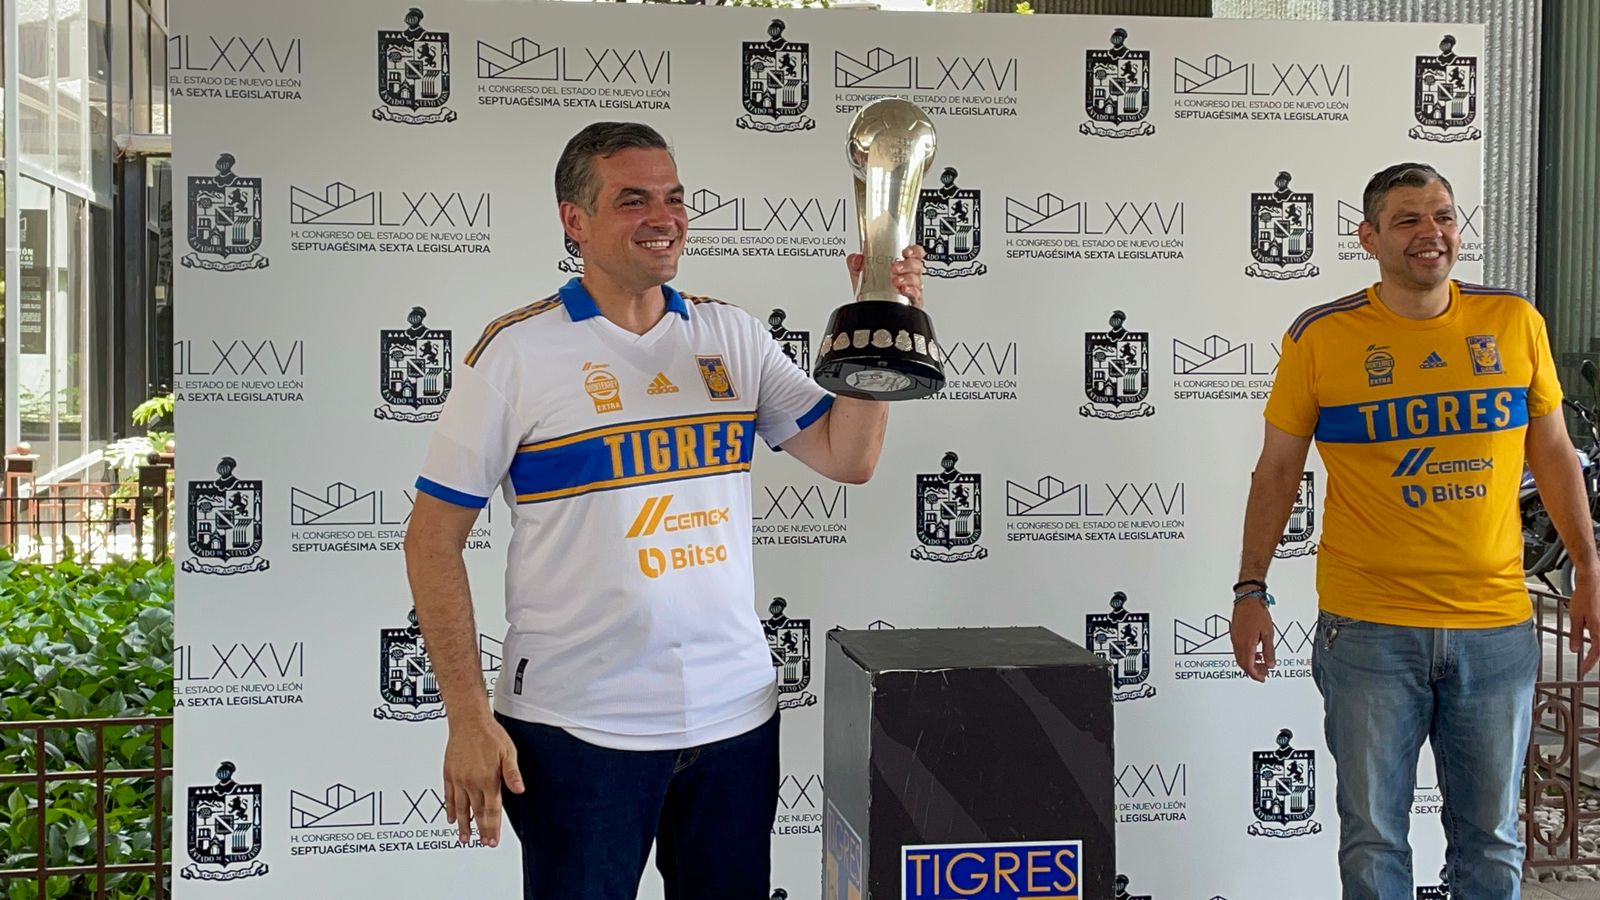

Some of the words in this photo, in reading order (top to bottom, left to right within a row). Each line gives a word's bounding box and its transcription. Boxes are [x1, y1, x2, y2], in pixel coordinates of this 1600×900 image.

[186, 35, 301, 74] LXXVI
[563, 47, 670, 84] LXXVI
[916, 56, 1017, 91] LXXVI
[183, 76, 222, 86] ESTADO
[224, 77, 237, 86] DE
[239, 78, 273, 87] NUEVO
[275, 78, 301, 88] LEÓN
[1252, 64, 1349, 96] LXXVI
[187, 88, 223, 98] SEXTA
[225, 90, 302, 100] LEGISLATURA
[488, 85, 540, 94] CONGRESO
[541, 86, 559, 95] DEL
[561, 87, 597, 96] ESTADO
[598, 88, 611, 96] DE
[612, 89, 644, 97] NUEVO
[646, 89, 670, 98] LEÓN
[478, 96, 561, 106] SEPTUAGÉSIMA
[563, 98, 597, 108] SEXTA
[599, 100, 671, 110] LEGISLATURA
[913, 95, 947, 103] ESTADO
[993, 96, 1017, 104] LEÓN
[1183, 100, 1230, 108] CONGRESO
[1326, 101, 1349, 110] LEÓN
[949, 107, 1017, 116] LEGISLATURA
[1174, 110, 1249, 120] SEPTUAGÉSIMA
[1251, 112, 1282, 120] SEXTA
[1284, 112, 1349, 121] LEGISLATURA
[379, 192, 490, 227] LXXVI
[742, 198, 845, 232] LXXVI
[1084, 202, 1183, 235] LXXVI
[302, 230, 355, 239] CONGRESO
[356, 231, 375, 240] DEL
[377, 232, 414, 240] ESTADO
[416, 232, 429, 240] DE
[430, 233, 463, 241] NUEVO
[465, 232, 490, 241] LEÓN
[685, 235, 720, 244] NGRESO
[721, 236, 738, 244] DEL
[740, 236, 775, 245] ESTADO
[776, 237, 788, 245] DE
[790, 237, 821, 245] NUEVO
[822, 236, 846, 245] LEÓN
[291, 241, 377, 252] SEPTUAGÉSIMA
[379, 244, 414, 252] SEXTA
[417, 244, 491, 253] LEGISLATURA
[1015, 239, 1063, 247] CONGRESO
[1161, 239, 1184, 248] LEÓN
[742, 248, 775, 256] SEXTA
[777, 248, 846, 257] LEGISLATURA
[1006, 249, 1082, 259] SEPTUAGÉSIMA
[1084, 251, 1116, 259] SEXTA
[1118, 251, 1184, 259] LEGISLATURA
[188, 340, 303, 375] LXXVI
[943, 342, 1016, 375] XXVI
[185, 381, 224, 389] ESTADO
[226, 381, 239, 389] DE
[241, 381, 275, 389] NUEVO
[277, 380, 303, 389] LEÓN
[993, 380, 1017, 388] LEÓN
[188, 393, 224, 402] SEXTA
[227, 393, 304, 402] LEGISLATURA
[950, 392, 1017, 400] LEGISLATURA
[1174, 390, 1248, 400] SEPTUAGÉSIMA
[597, 402, 621, 412] EXTRA
[1358, 391, 1512, 440] TIGRES
[603, 422, 744, 478] TIGRES
[1426, 458, 1493, 475] CEMEX
[1432, 483, 1486, 502] Bitso
[1085, 483, 1184, 516] LXXVI
[664, 508, 729, 532] CEMEX
[1016, 522, 1064, 530] CONGRESO
[1083, 521, 1116, 529] ESTADO
[1161, 519, 1184, 528] LEÓN
[752, 523, 776, 533] TADO
[823, 523, 847, 532] LEÓN
[302, 531, 356, 540] CONGRESO
[377, 530, 407, 539] ESTAD
[752, 534, 776, 546] EXTA
[778, 536, 847, 545] LEGISLATURA
[1007, 531, 1083, 542] SEPTUAGÉSIMA
[1085, 532, 1116, 541] SEXTA
[1118, 532, 1185, 540] LEGISLATURA
[292, 541, 377, 552] SEPTUAGÉSIMA
[671, 544, 727, 570] Bitso
[188, 642, 303, 680] LXXVI
[1184, 660, 1231, 668] CONGRESO
[1285, 659, 1295, 667] DE
[1175, 670, 1248, 680] SEPTUAGÉSIMA
[185, 685, 224, 694] ESTADO
[225, 685, 239, 693] DE
[241, 684, 275, 692] NUEVO
[276, 682, 303, 692] LEÓN
[187, 697, 224, 707] SEXTA
[227, 695, 303, 706] LEGISLATURA
[1114, 764, 1186, 798] XXVI
[1119, 803, 1131, 811] DE
[1132, 802, 1162, 810] NUEVO
[1163, 800, 1186, 810] LEÓN
[777, 815, 790, 823] DE
[791, 814, 823, 822] NUEVO
[1120, 812, 1187, 823] LEGISLATURA
[301, 833, 355, 843] CONGRESO
[356, 832, 375, 840] DEL
[377, 830, 414, 840] ESTADO
[416, 830, 429, 838] DE
[291, 843, 376, 856] SEPTUAGÉSIMA
[379, 842, 414, 852] SEXTA
[908, 849, 1077, 896] TIGRES
